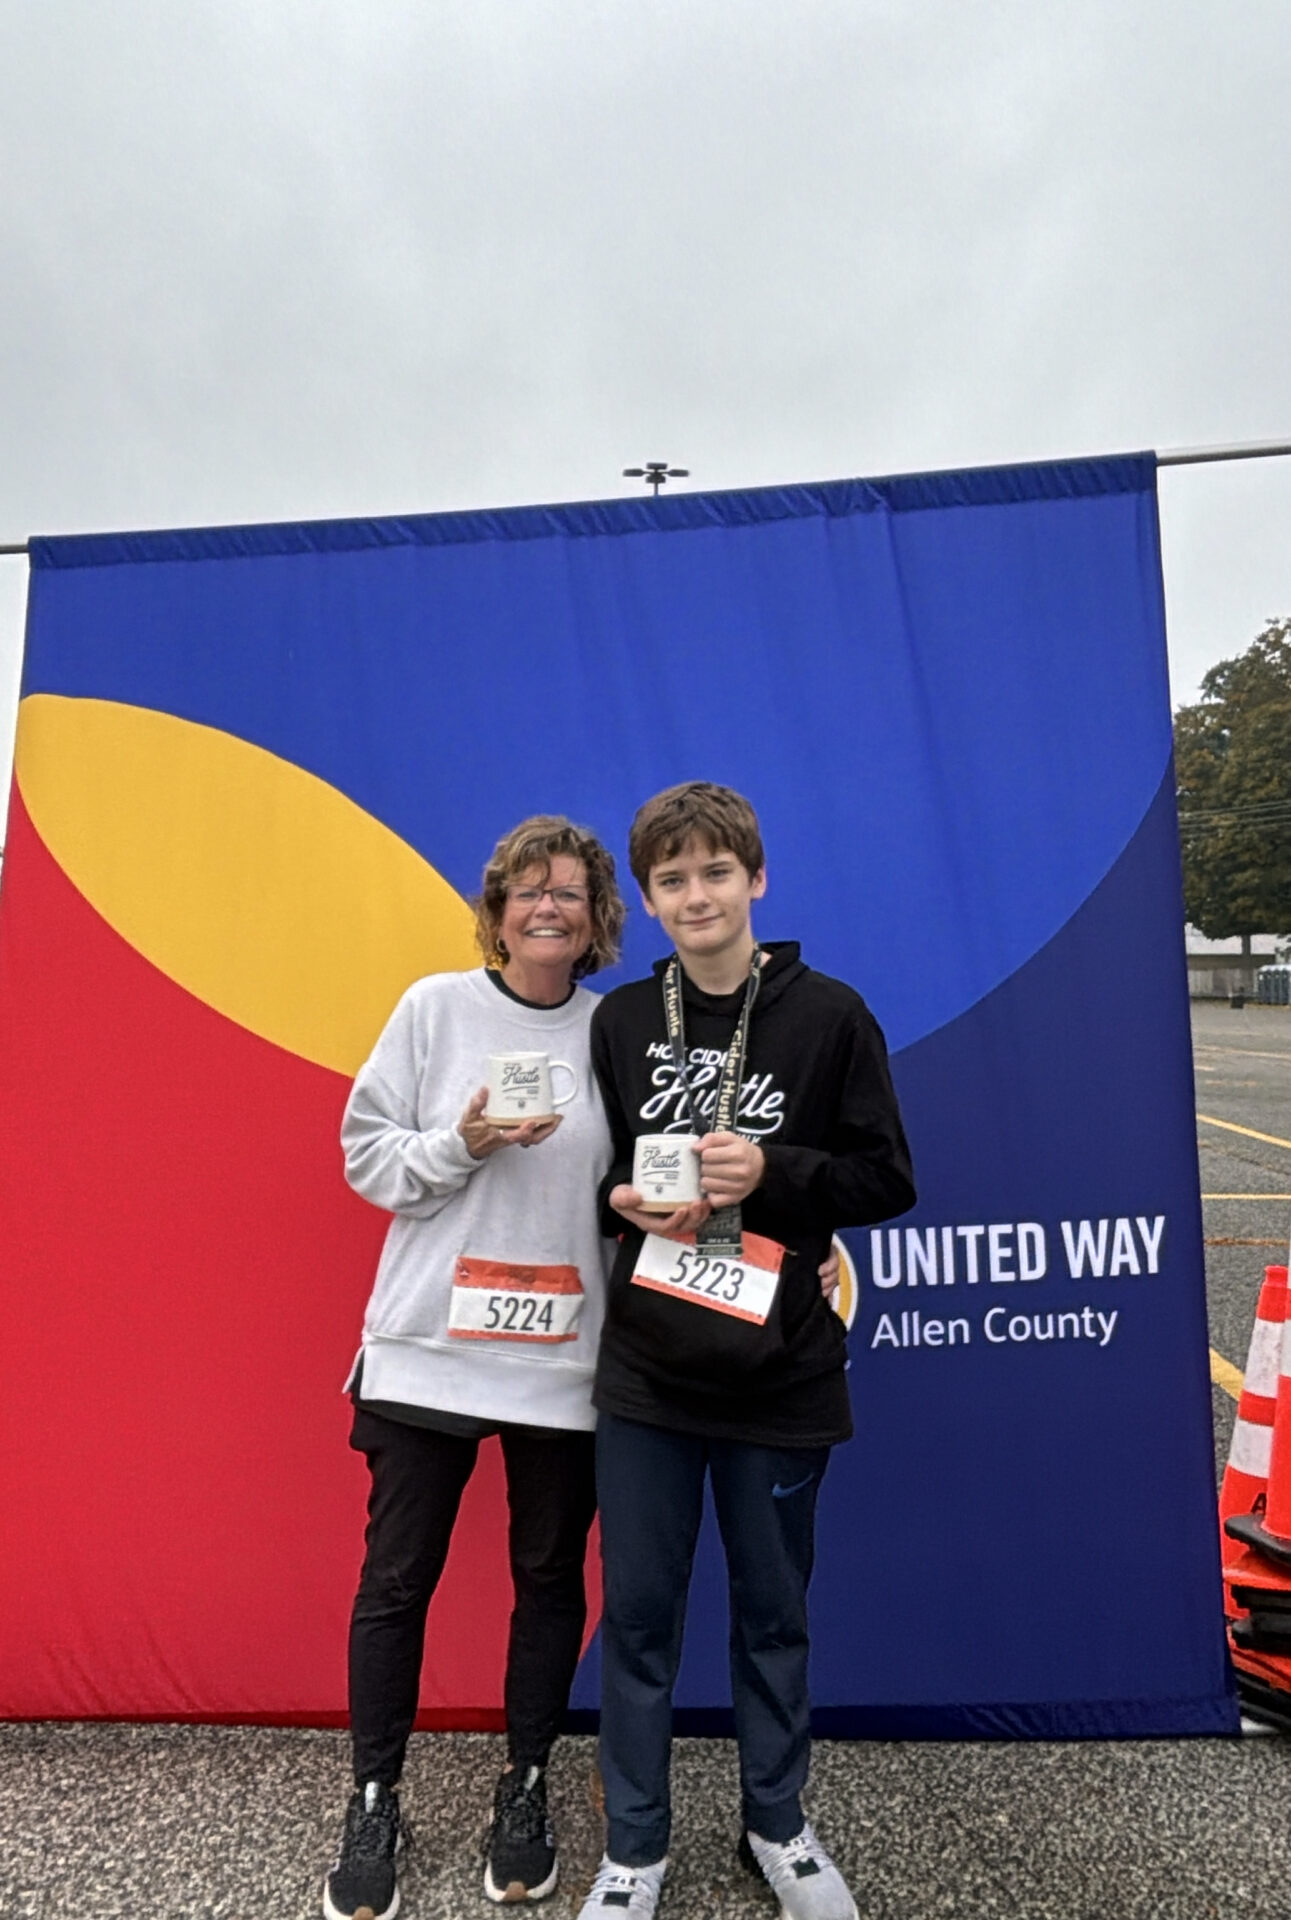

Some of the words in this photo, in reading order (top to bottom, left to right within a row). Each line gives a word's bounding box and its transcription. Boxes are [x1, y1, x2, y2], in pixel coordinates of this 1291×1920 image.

[665, 987, 680, 1038] Hustle
[646, 1042, 691, 1061] HO
[639, 1064, 785, 1135] Hutle
[641, 1149, 682, 1169] Hustle
[870, 1222, 1047, 1289] UNITED
[1061, 1215, 1165, 1279] WAY
[668, 1250, 745, 1302] 5223
[484, 1295, 553, 1332] 5224
[870, 1310, 969, 1350] Allen
[983, 1306, 1119, 1347] County
